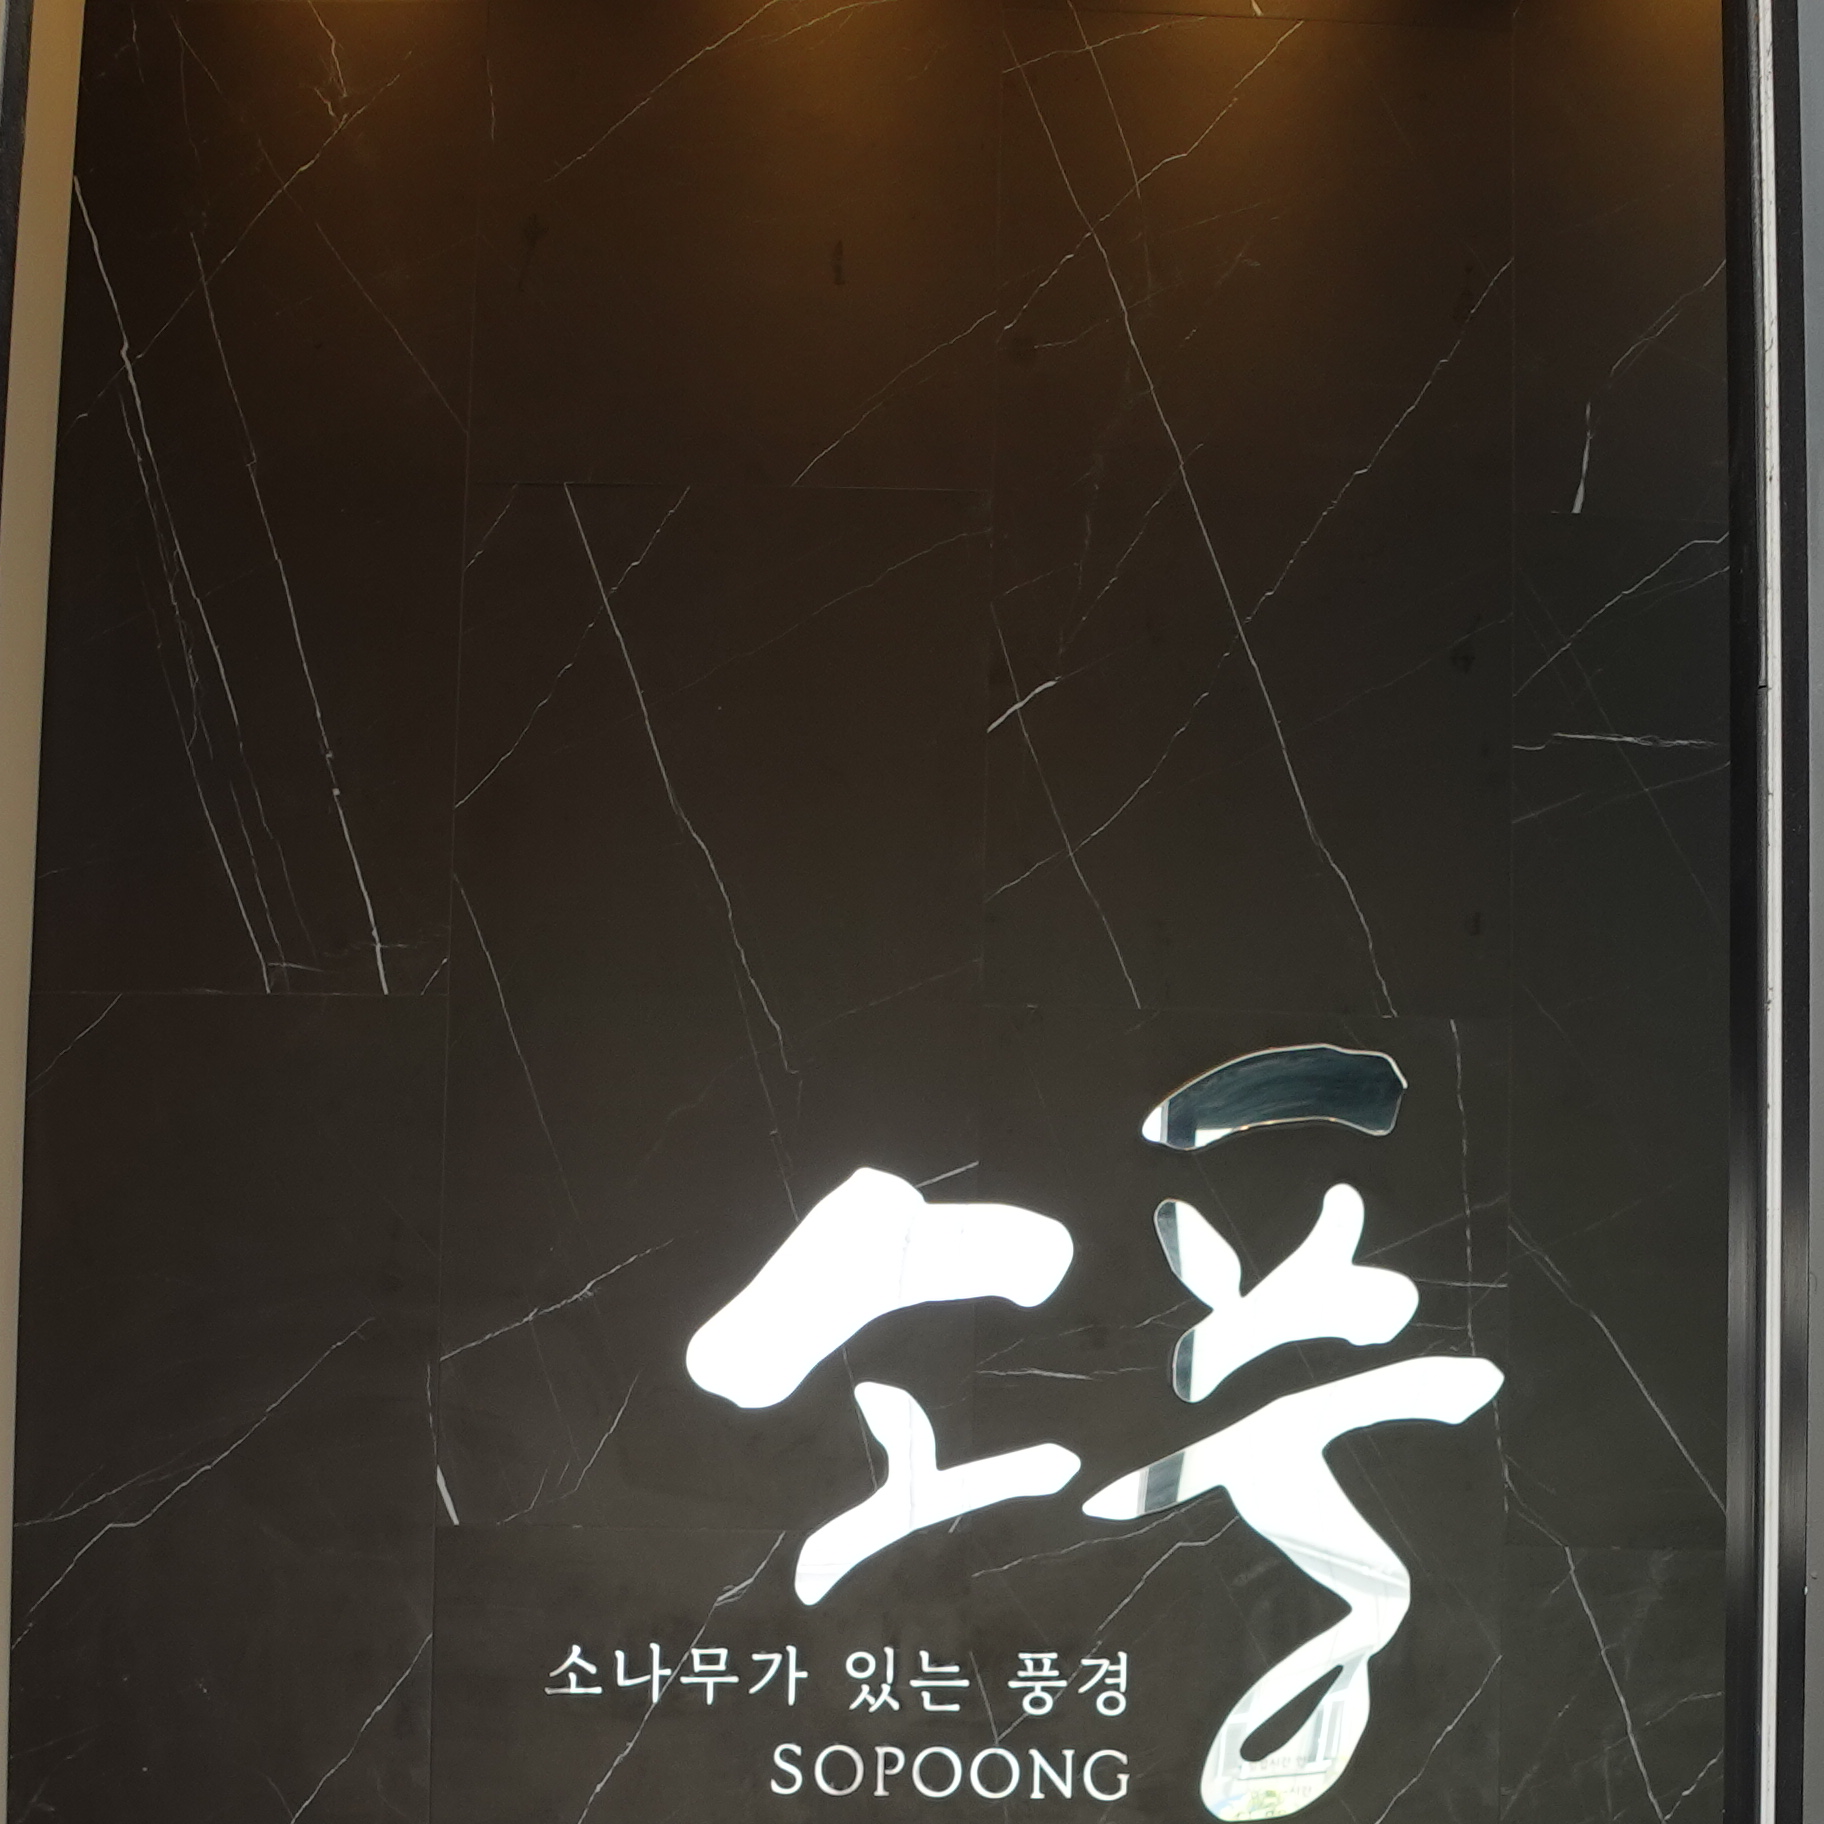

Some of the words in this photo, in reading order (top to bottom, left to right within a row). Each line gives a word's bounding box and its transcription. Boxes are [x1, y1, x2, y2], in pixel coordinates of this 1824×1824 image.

[686, 1043, 1504, 1821] 소풍
[544, 1642, 808, 1708] 소나무가
[844, 1647, 970, 1714] 있는
[1006, 1650, 1132, 1717] 풍경
[770, 1742, 1132, 1801] SOPOONG
